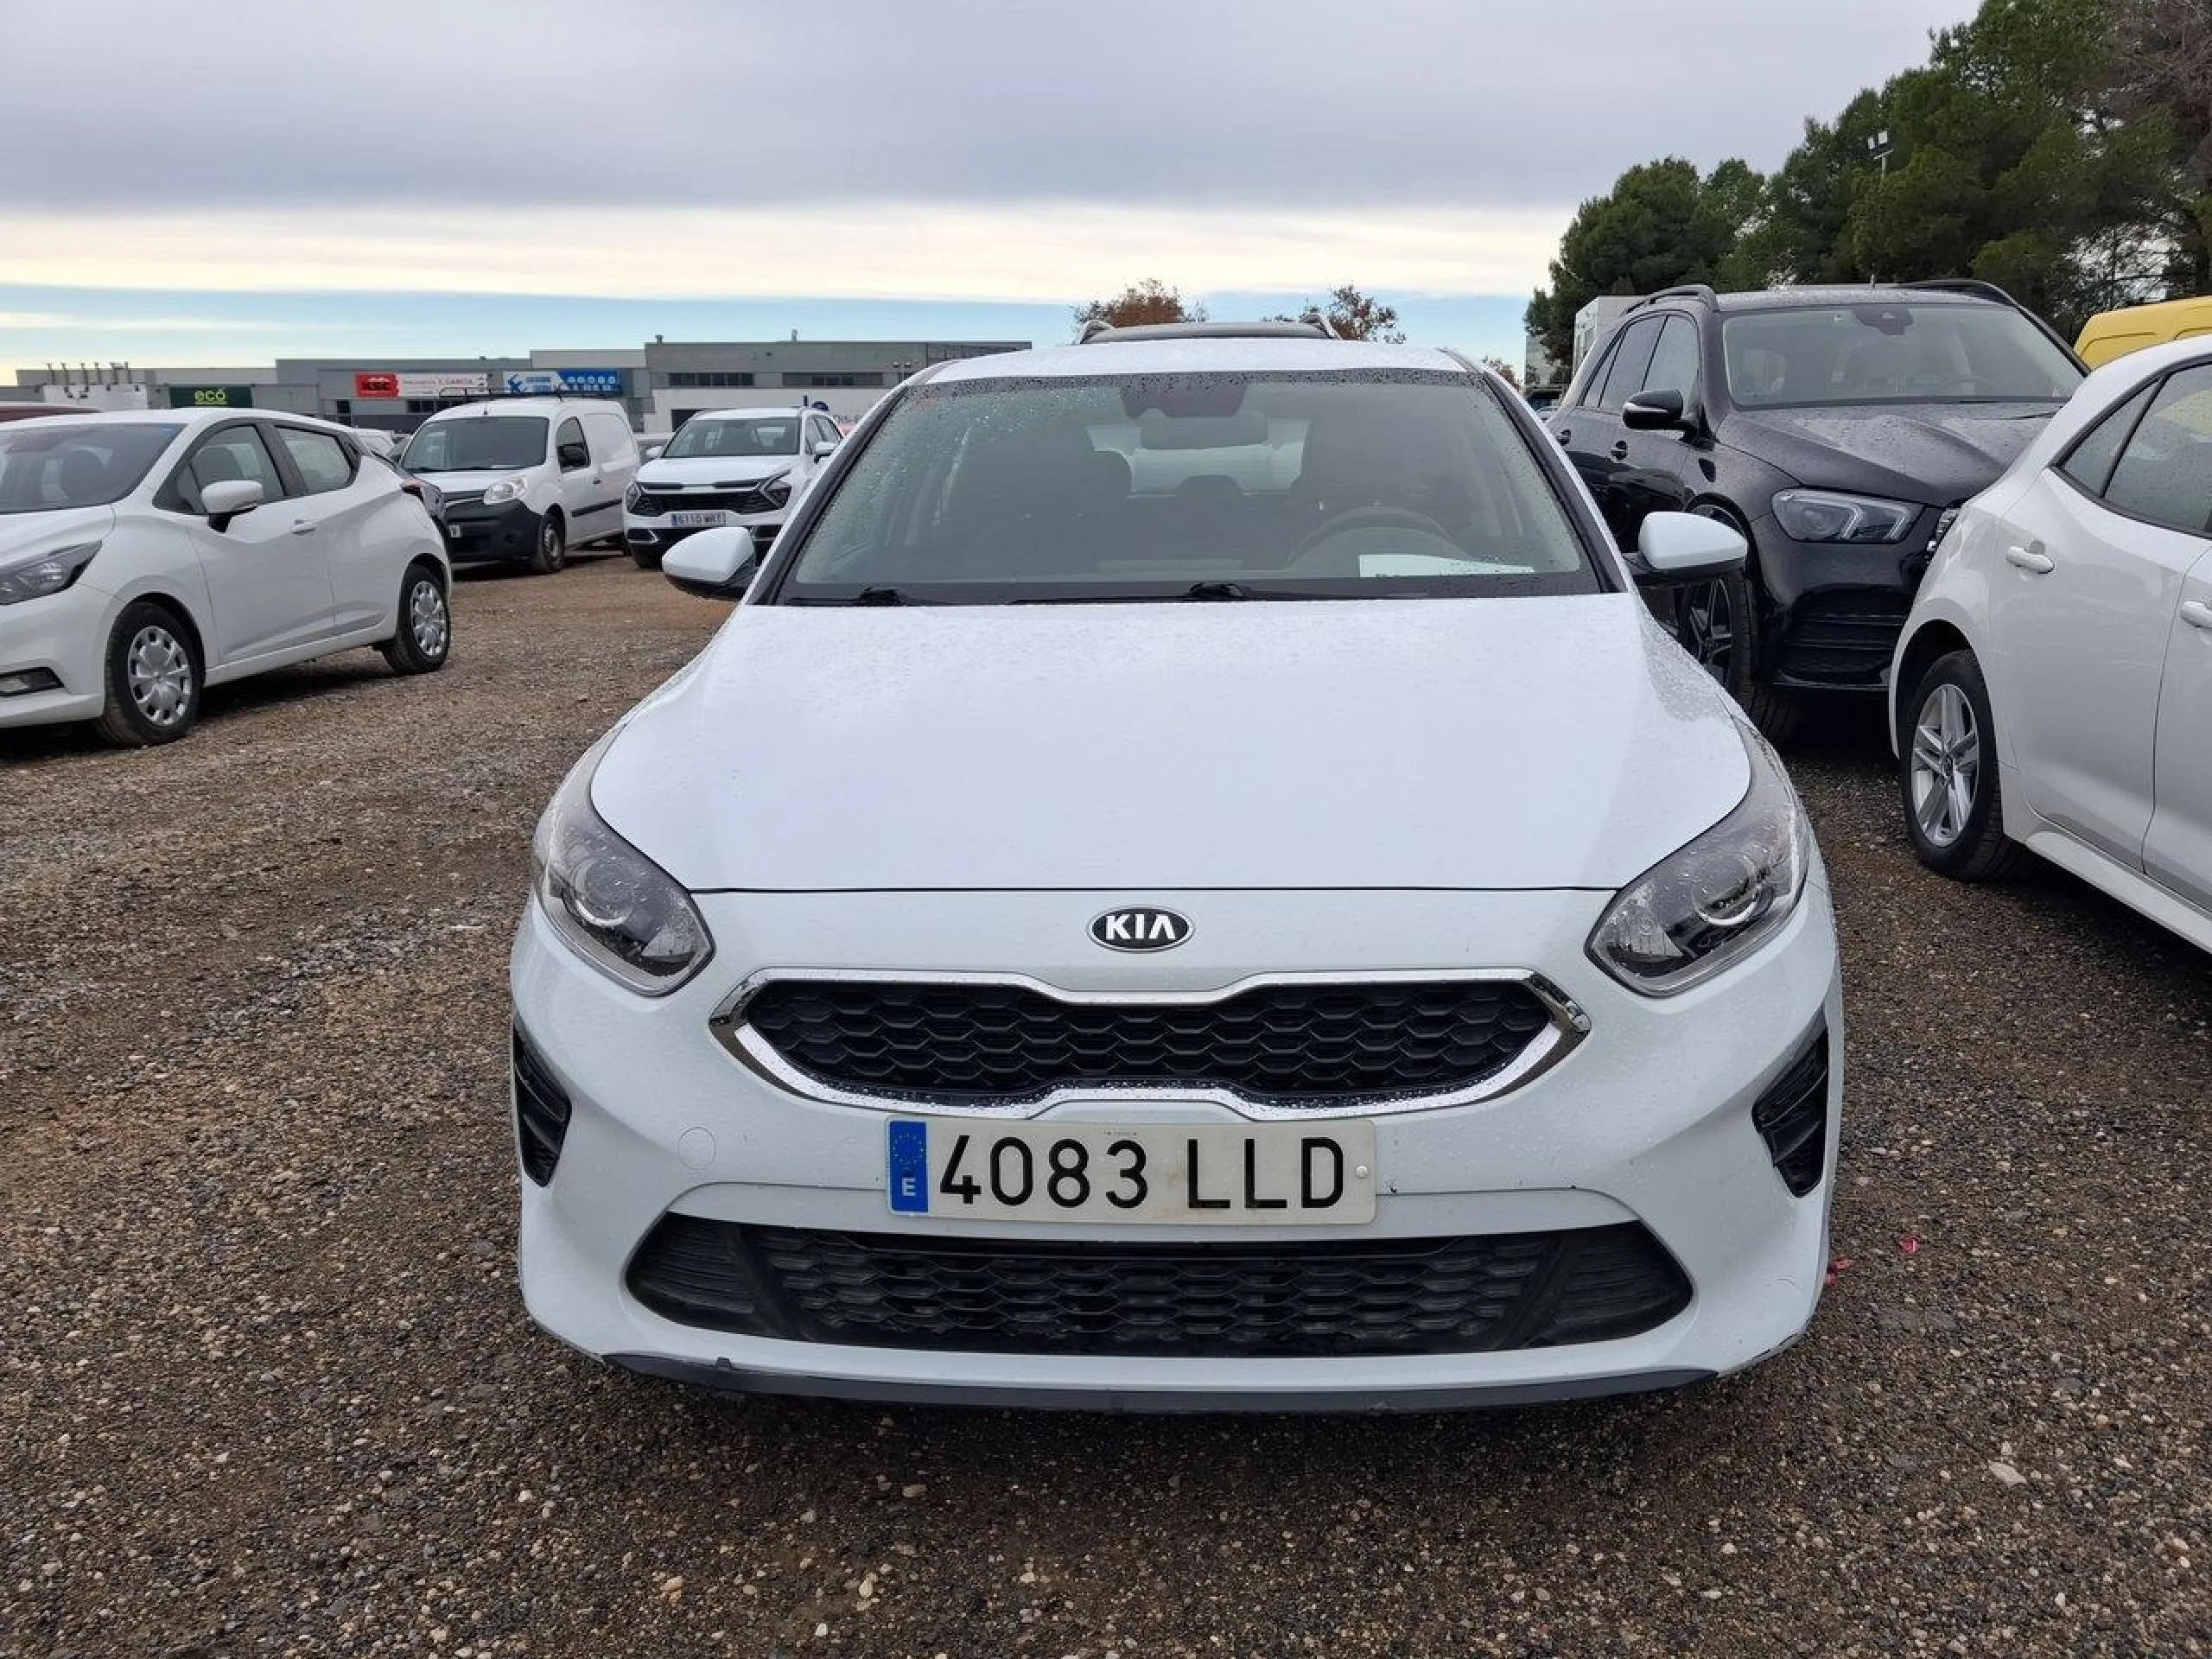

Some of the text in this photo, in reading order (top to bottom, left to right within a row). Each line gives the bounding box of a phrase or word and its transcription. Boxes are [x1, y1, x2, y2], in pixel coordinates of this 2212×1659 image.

[1106, 913, 1176, 939] KIA
[939, 1134, 1344, 1210] 4083 LLD
[902, 1177, 916, 1197] E
